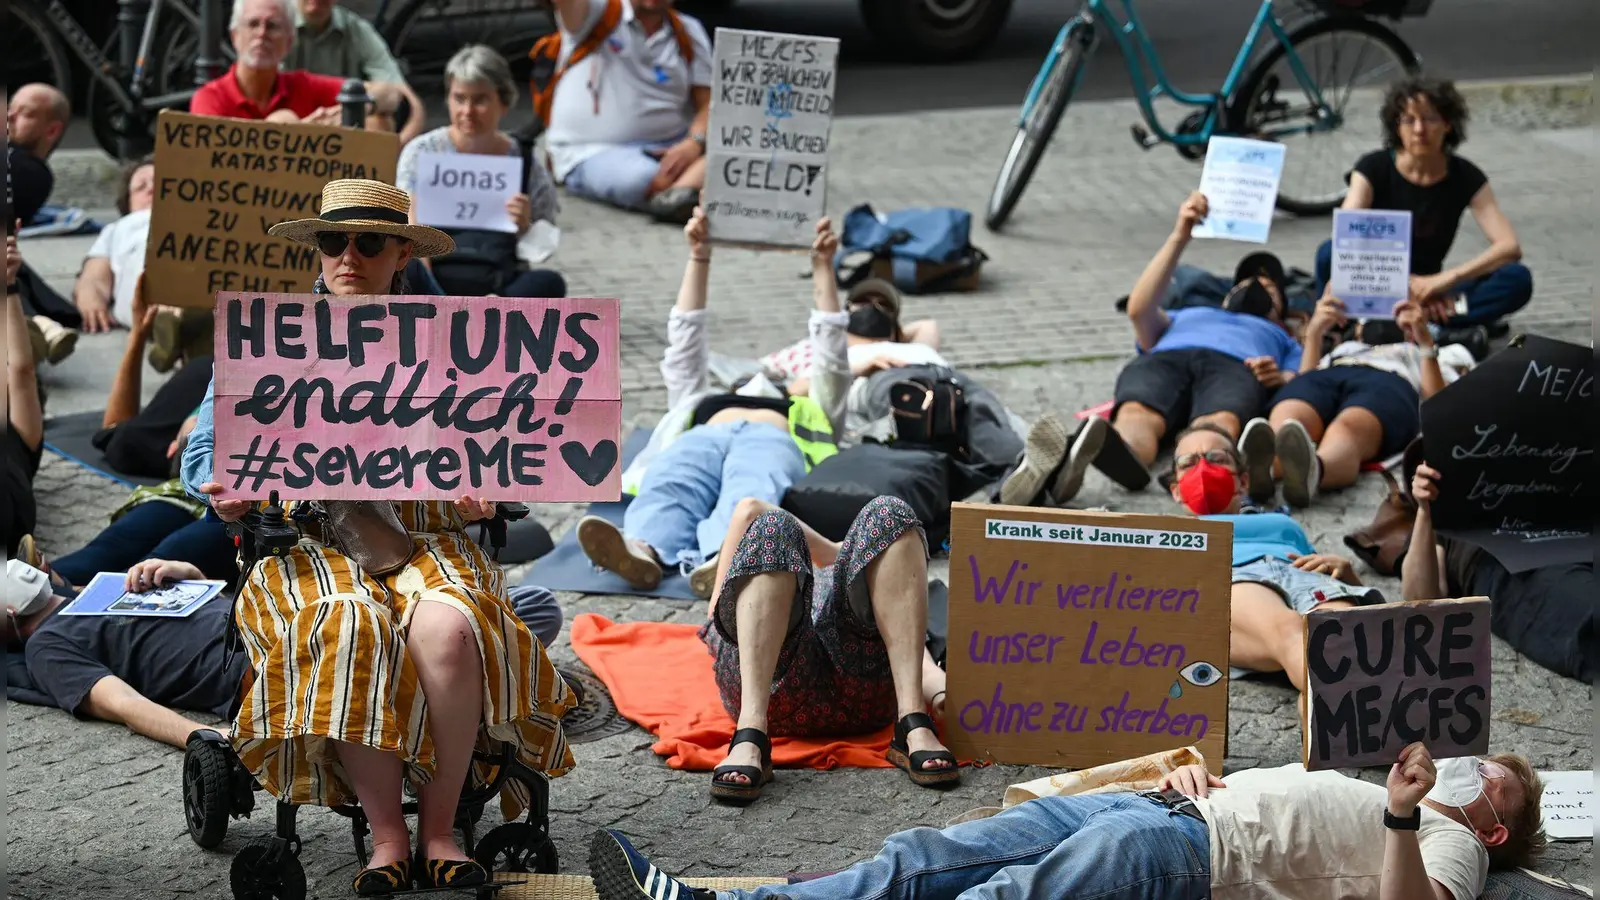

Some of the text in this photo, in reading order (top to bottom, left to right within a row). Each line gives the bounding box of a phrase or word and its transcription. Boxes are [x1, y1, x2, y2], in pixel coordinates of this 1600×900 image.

[721, 60, 832, 90] WIR BRAUCHEN
[721, 84, 764, 107] KEIN
[164, 122, 343, 156] VERSORGUNG
[721, 125, 825, 154] WIR BRAUCHEN
[429, 163, 508, 192] Jonas
[723, 157, 821, 197] GELD!
[206, 209, 239, 231] ZU
[455, 201, 480, 221] 27
[156, 231, 322, 272] ANERKENN
[227, 298, 600, 375] HELFT UNS
[234, 359, 584, 438] endlich!
[226, 434, 548, 493] #severeME
[1466, 470, 1559, 510] begraben
[987, 522, 1205, 548] Krank seit Januar 2023
[968, 554, 1201, 614] Wir verlieren
[968, 620, 1187, 668] unser Leben
[1308, 612, 1475, 685] CURE
[959, 681, 1209, 740] ohne zu sterben
[1312, 680, 1486, 761] ME/CFS
